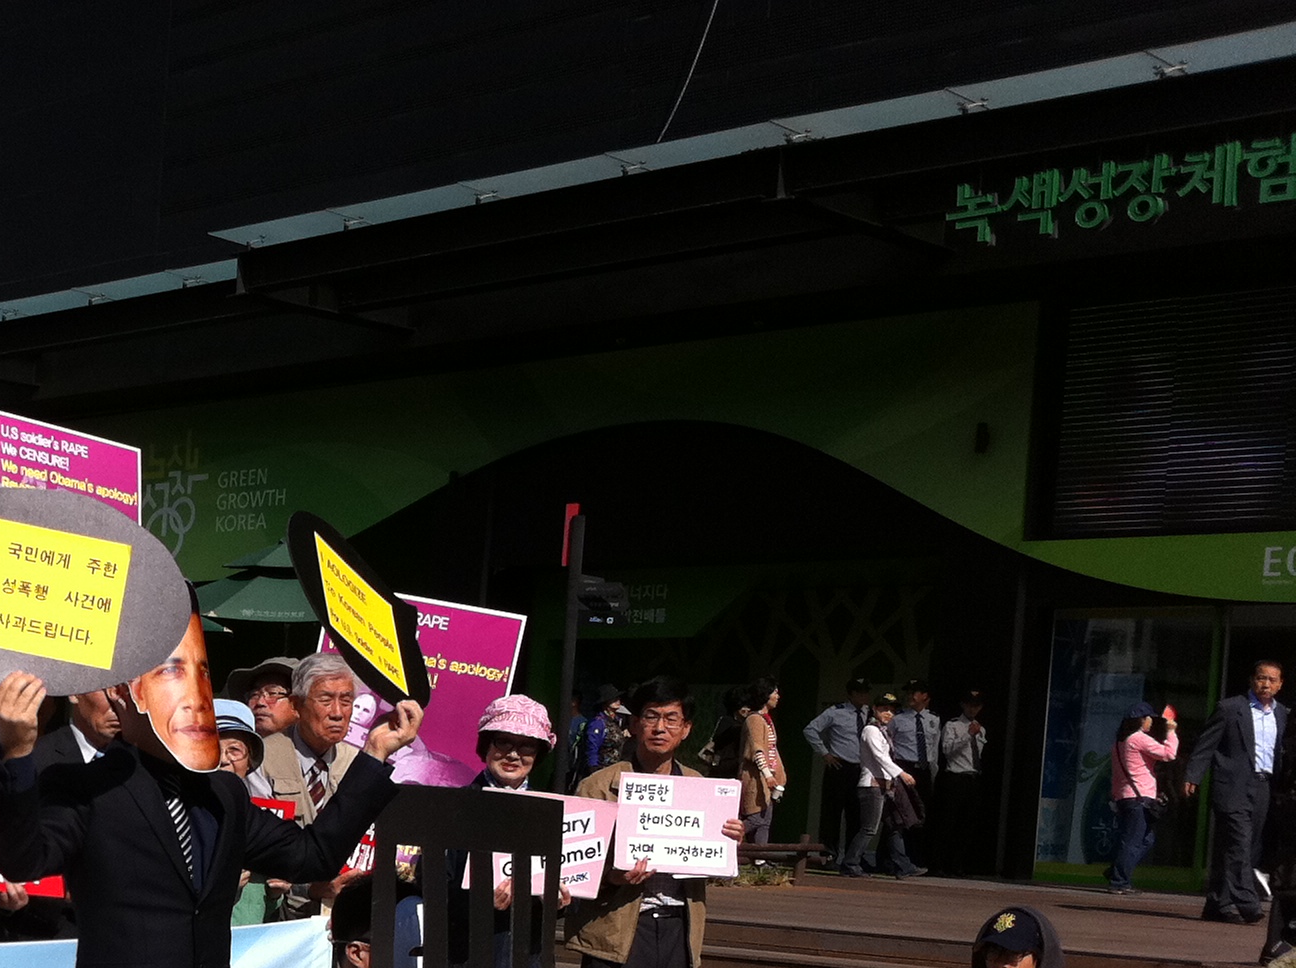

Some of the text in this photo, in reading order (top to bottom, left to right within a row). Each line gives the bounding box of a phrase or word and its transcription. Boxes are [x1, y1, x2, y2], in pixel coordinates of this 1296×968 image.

[20, 430, 59, 451] soldier's
[61, 440, 88, 458] RAPE
[1, 442, 70, 470] We CENSURE!
[1, 459, 18, 474] We
[20, 464, 47, 482] need
[50, 471, 94, 493] Obama's
[96, 484, 138, 506] apology!
[217, 468, 268, 488] GREEN
[216, 488, 286, 511] GROWTH
[215, 513, 267, 532] KOREA
[8, 542, 72, 569] 국민에게
[86, 558, 118, 579] 주한
[2, 577, 49, 601] 성폭행
[64, 591, 112, 613] 사건에
[449, 661, 510, 683] apology!
[625, 782, 669, 802] 불평등한
[639, 812, 700, 831] 한미SOFA
[664, 845, 724, 863] 개정하라!
